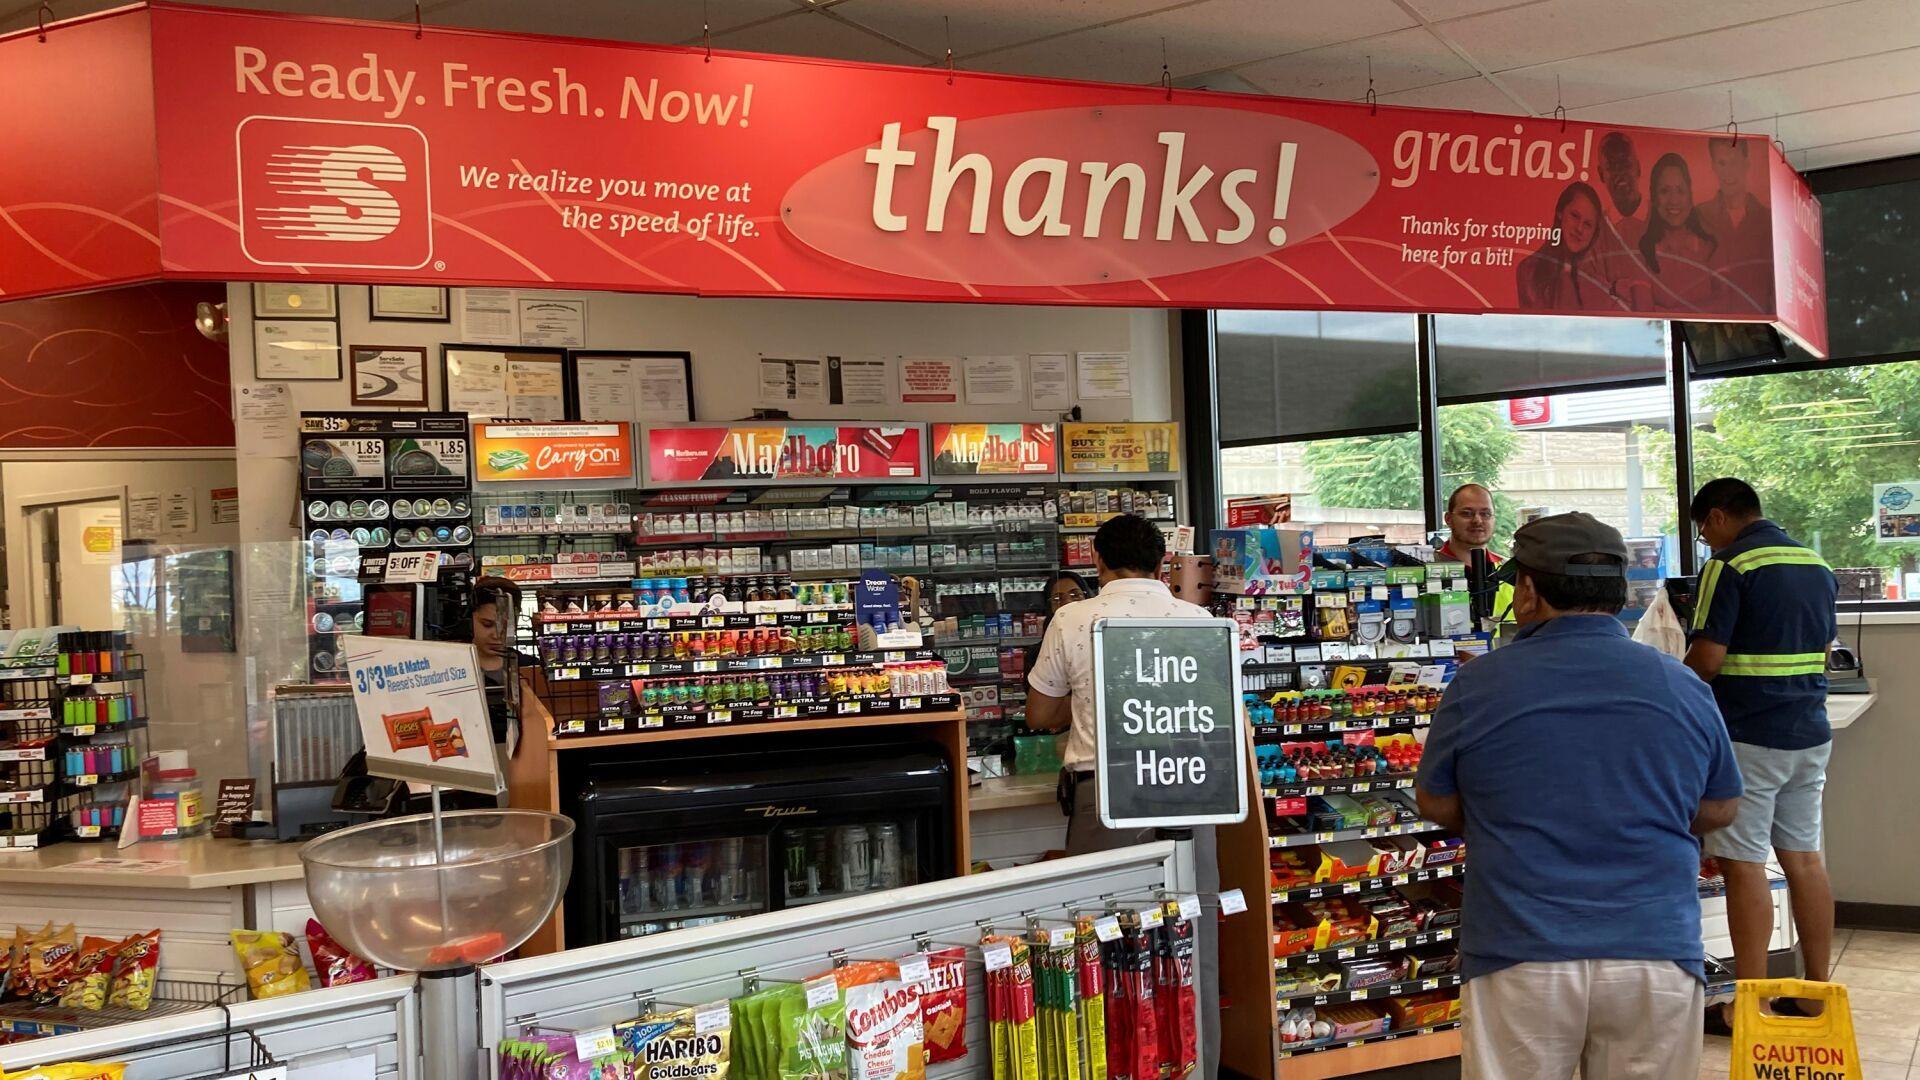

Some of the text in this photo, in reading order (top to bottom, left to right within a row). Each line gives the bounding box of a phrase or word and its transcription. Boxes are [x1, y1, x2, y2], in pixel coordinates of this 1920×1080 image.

[235, 46, 754, 128] Ready. Fresh. Now!
[1391, 124, 1594, 188] gracias!
[459, 166, 752, 203] We realize you move at
[865, 116, 1298, 248] thanks!
[562, 206, 760, 243] the speed of life.
[1401, 215, 1562, 246] Thanks for stopping
[1401, 243, 1514, 269] here for a bit!
[304, 418, 324, 429] SAVE
[733, 433, 860, 476] Marlboro
[951, 433, 1039, 464] Marlboro
[1072, 439, 1095, 447] BUY
[536, 446, 588, 472] Carry
[401, 557, 420, 569] OFF
[383, 664, 398, 678] Mix
[398, 662, 405, 675] &
[405, 657, 430, 674] Match
[386, 666, 467, 692] Reese's Standard Size
[1135, 647, 1198, 684] Line
[1123, 698, 1215, 734] Starts
[1135, 750, 1206, 785] Here
[849, 984, 918, 1038] Combos
[645, 1034, 722, 1063] HARIBO
[863, 1049, 894, 1060] Cheddar
[1752, 1043, 1845, 1066] CAUTION
[649, 1063, 718, 1080] Goldbears
[867, 1059, 893, 1069] Cheese
[1753, 1063, 1845, 1080] Wet Floor
